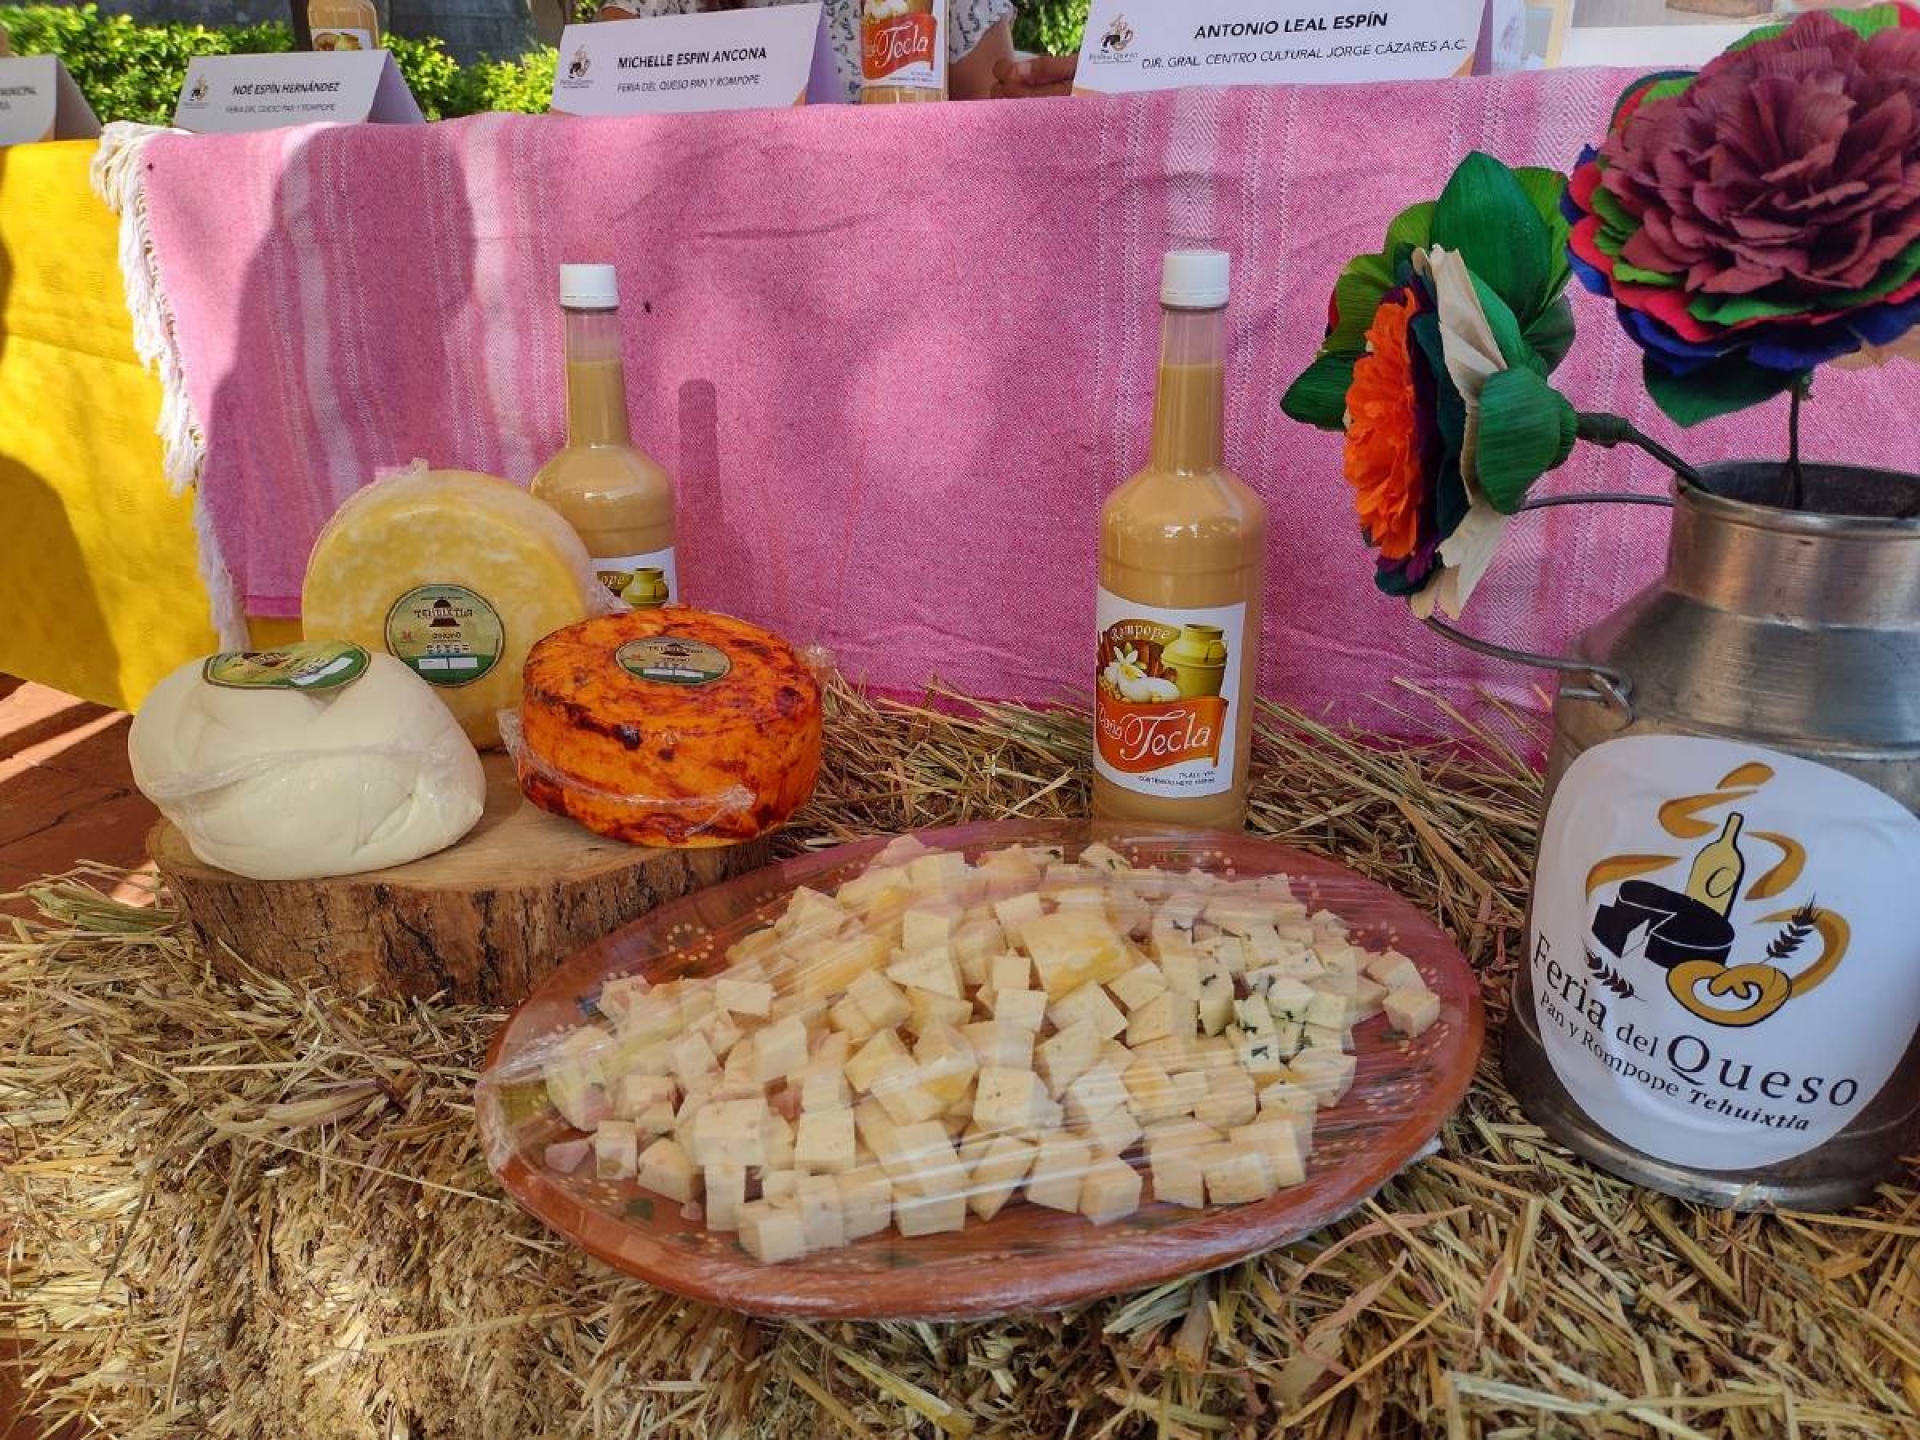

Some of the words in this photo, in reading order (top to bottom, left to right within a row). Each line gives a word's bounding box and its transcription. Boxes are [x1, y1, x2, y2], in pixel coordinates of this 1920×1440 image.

[1194, 20, 1279, 39] ANTONIO
[1284, 17, 1327, 33] LEAL
[1333, 11, 1388, 29] ESPÍN
[617, 53, 673, 69] MICHELLE
[676, 50, 709, 66] ESPIN
[711, 47, 767, 63] ANCONA
[1205, 52, 1257, 65] CENTRO
[1260, 48, 1323, 62] CULTURAL
[1326, 45, 1371, 58] JORGE
[1375, 41, 1437, 54] CÁZARES
[1119, 709, 1211, 761] Tecla
[1533, 934, 1607, 1033] Feria
[1616, 1023, 1659, 1058] del
[1667, 1034, 1859, 1107] Queso
[1540, 991, 1567, 1029] Pan
[1567, 1020, 1581, 1039] y
[1581, 1030, 1681, 1097] Rompope
[1688, 1088, 1811, 1133] Tehuixtla
